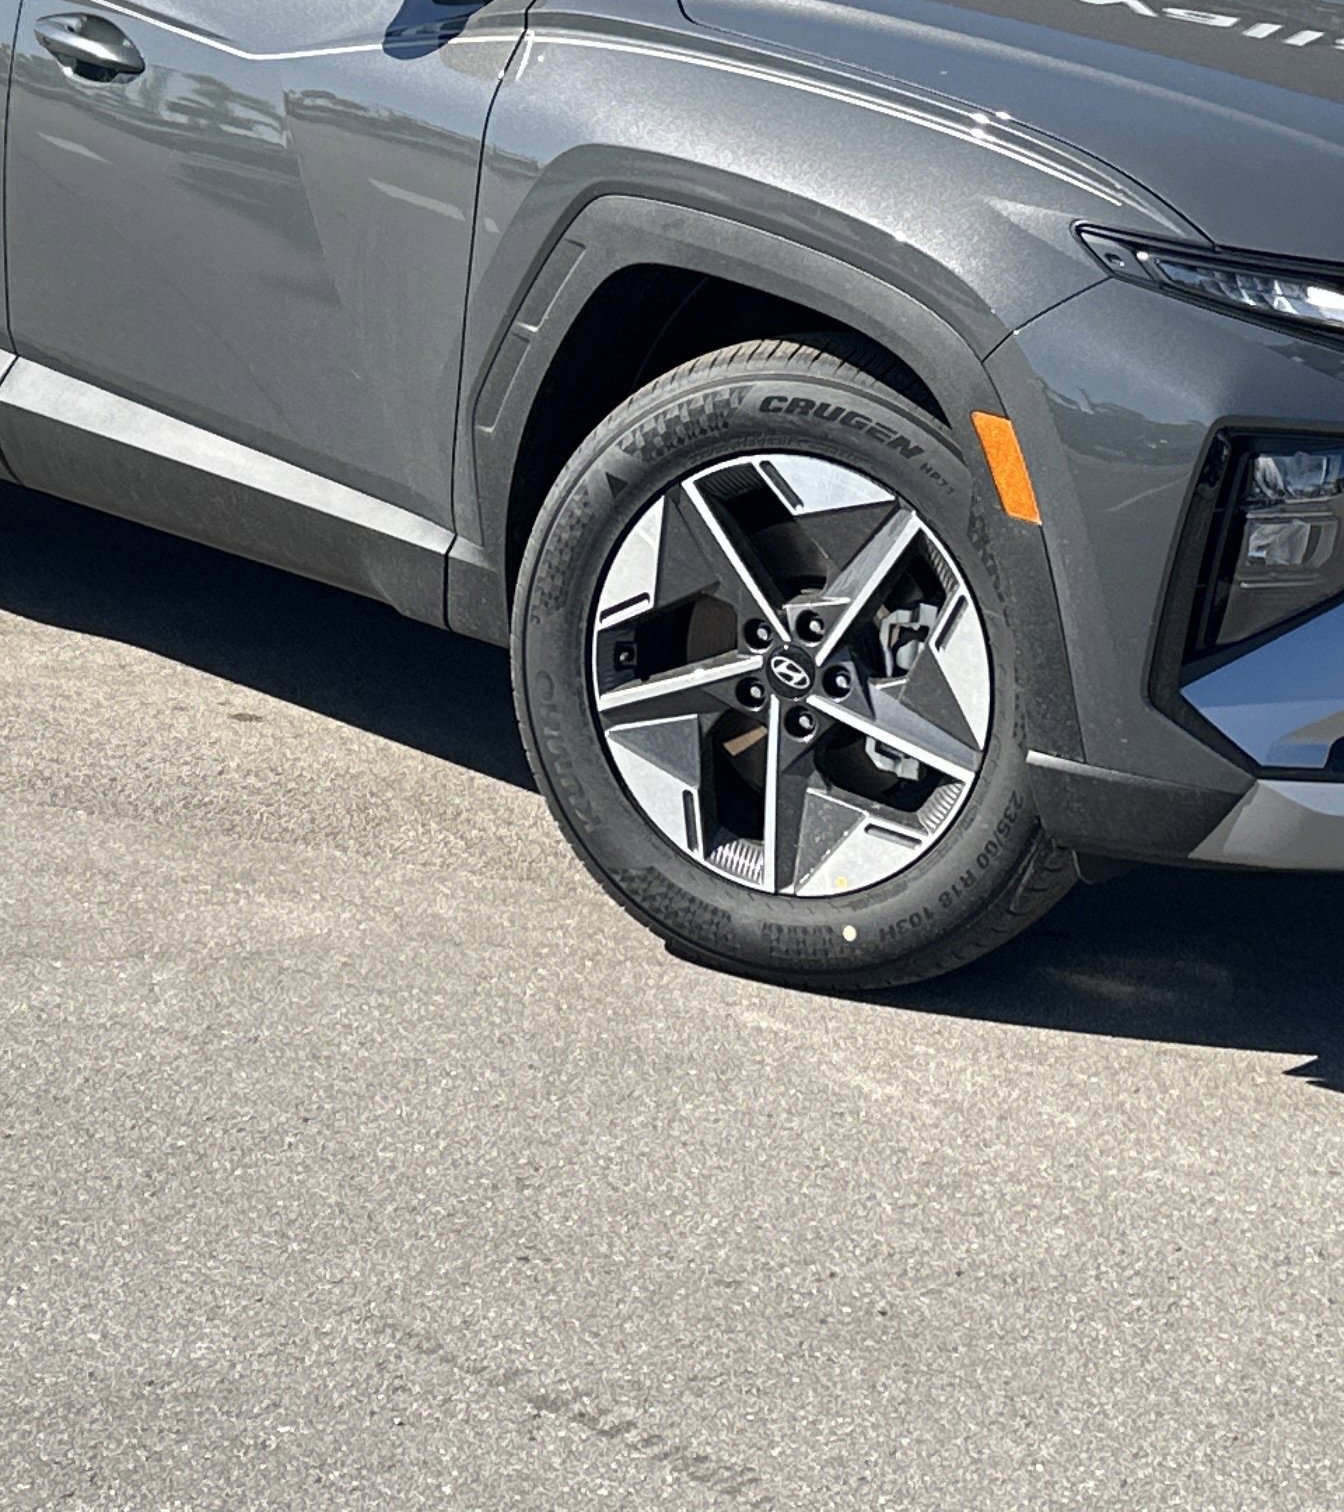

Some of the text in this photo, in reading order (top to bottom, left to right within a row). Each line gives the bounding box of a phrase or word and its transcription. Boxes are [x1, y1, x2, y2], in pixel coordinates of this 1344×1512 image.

[759, 395, 925, 460] CRUGEN
[878, 790, 1025, 943] 235/60 R18 103H
